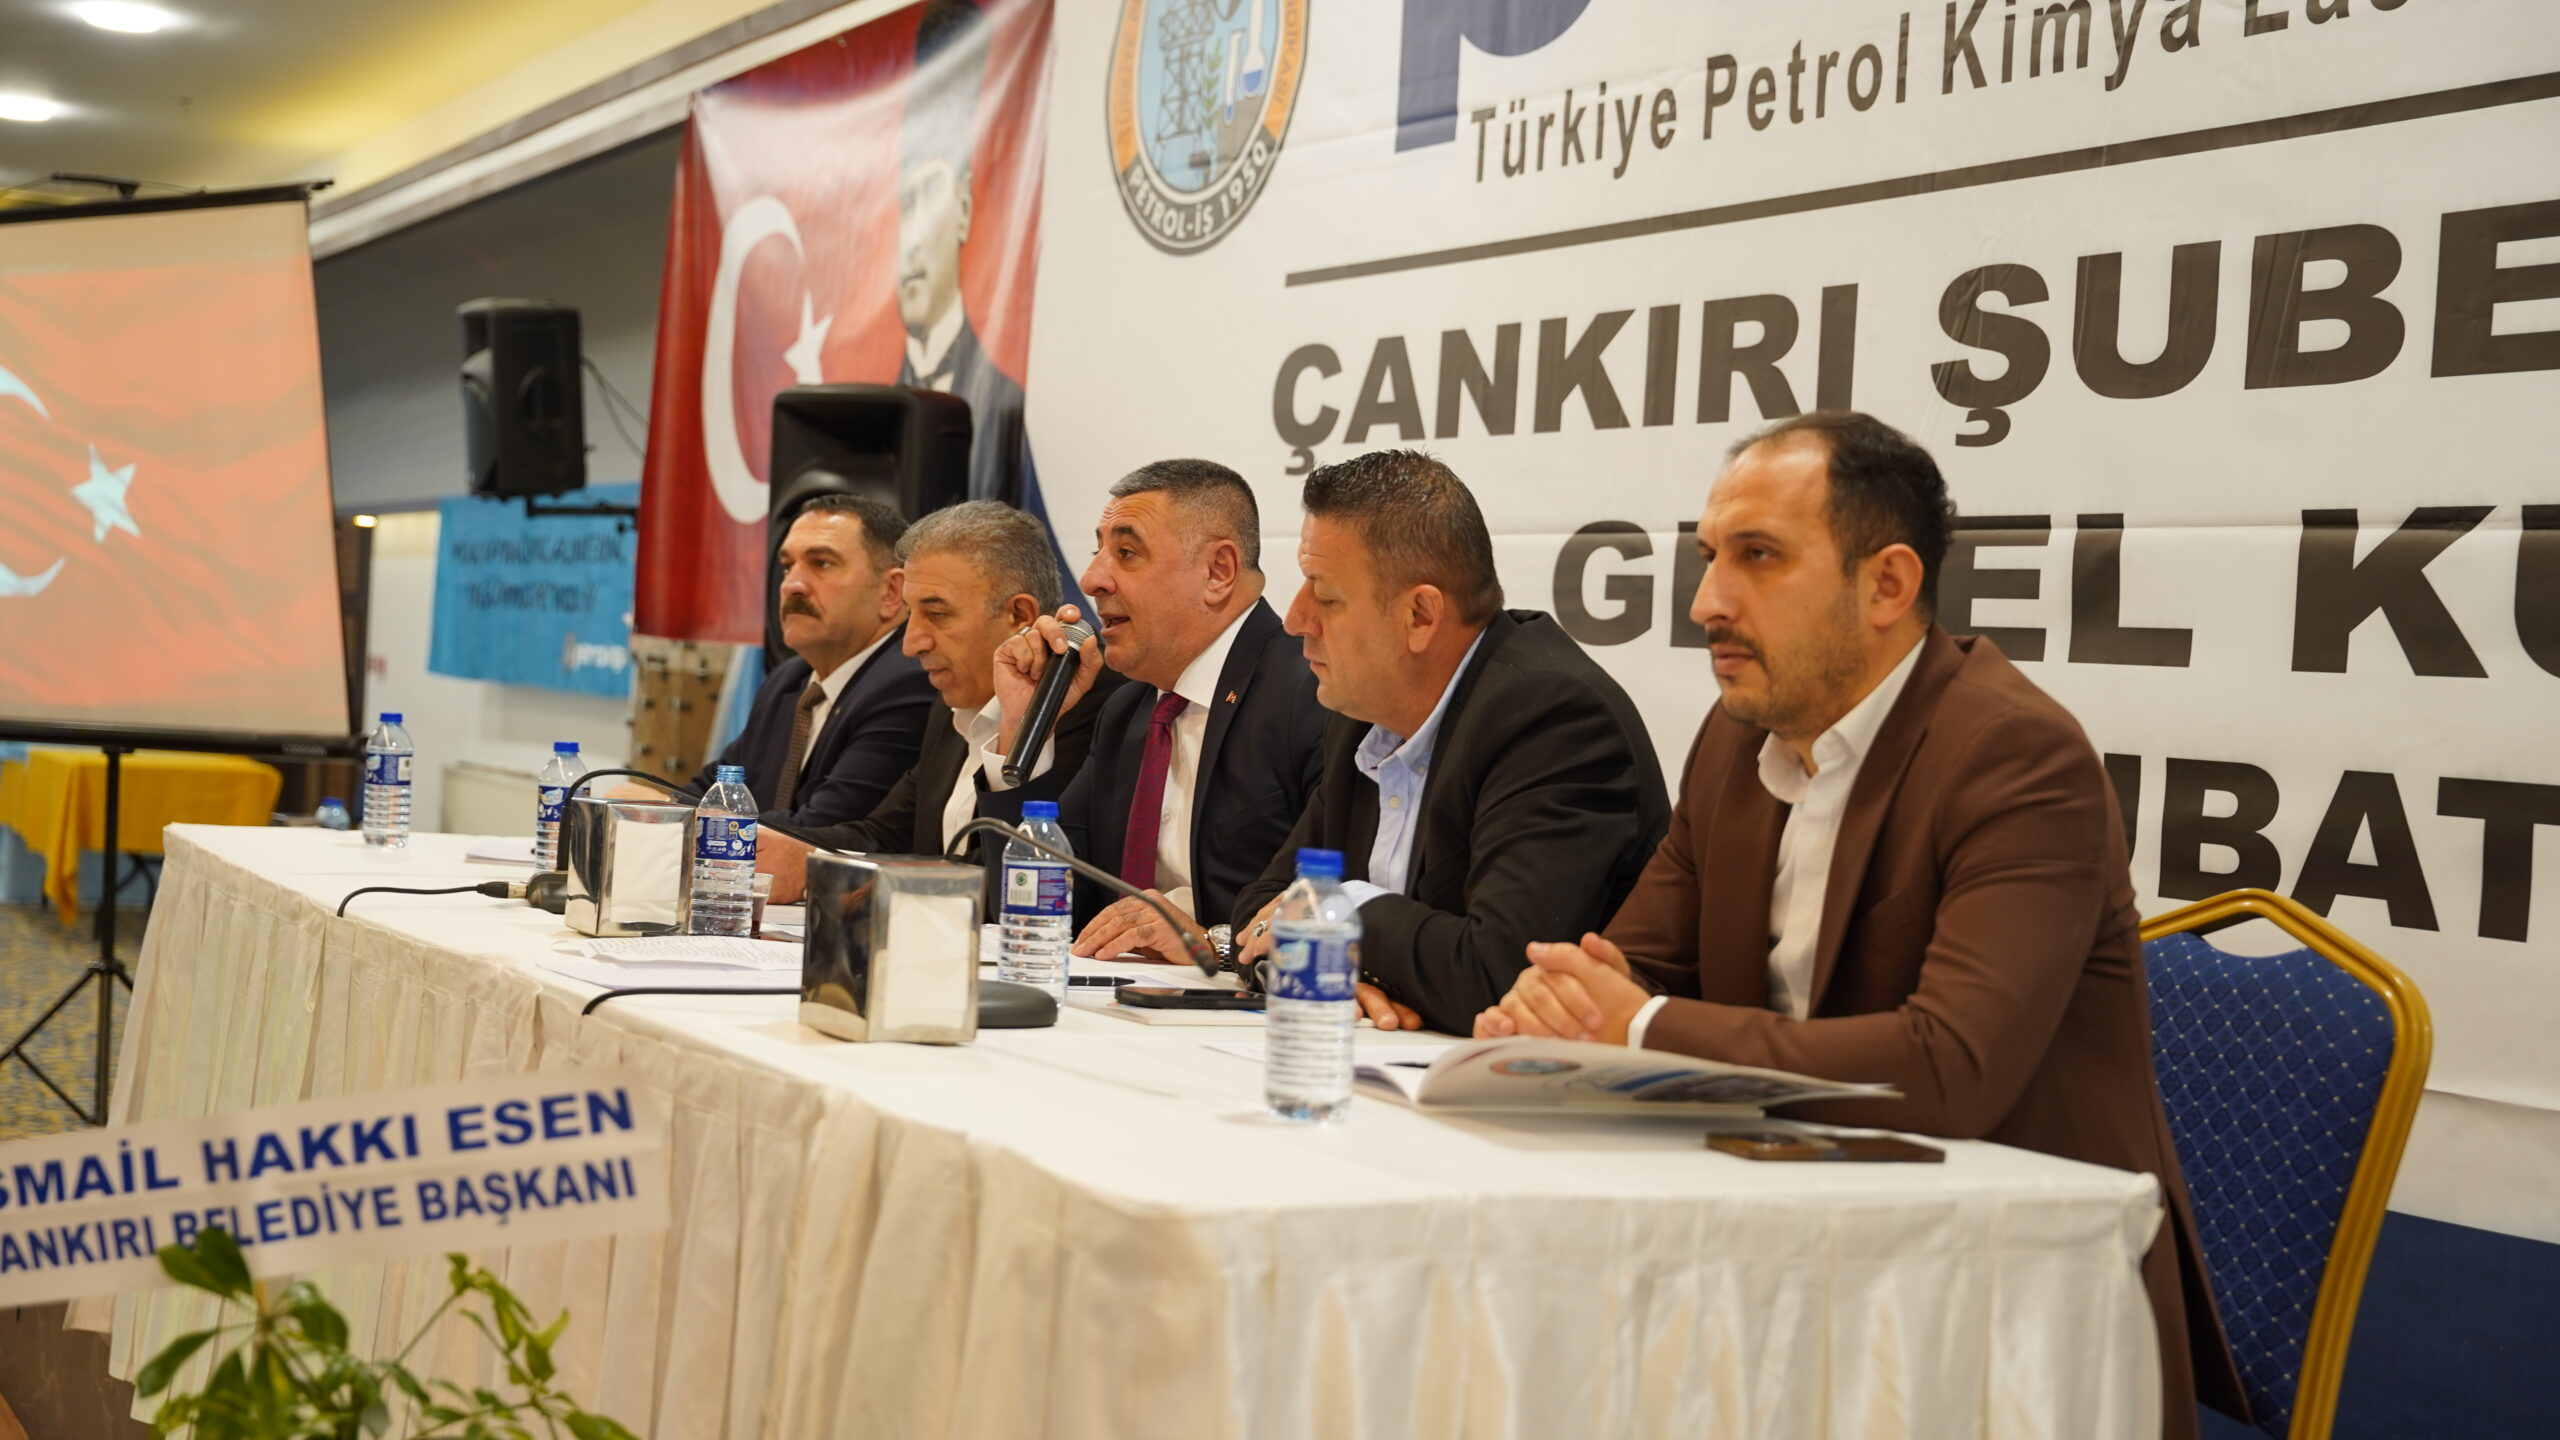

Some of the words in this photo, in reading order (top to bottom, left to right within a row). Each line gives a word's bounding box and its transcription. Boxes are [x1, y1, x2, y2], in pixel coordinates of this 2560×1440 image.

[1471, 80, 1678, 183] Türkiye
[1702, 11, 1910, 140] Petrol
[1941, 0, 2201, 95] Kimya
[1128, 164, 1214, 239] PETROL-İŞ
[1220, 140, 1268, 219] 1950
[1272, 282, 1859, 477] ÇANKIRI
[1930, 199, 2560, 448] ŞUBE
[1551, 509, 2194, 668] GEL
[2103, 752, 2560, 944] BAT
[0, 1215, 157, 1274] ANKIRI
[417, 1156, 637, 1226] BAŞKANI
[201, 1113, 422, 1187] HAKKI
[447, 1087, 635, 1152] ESEN
